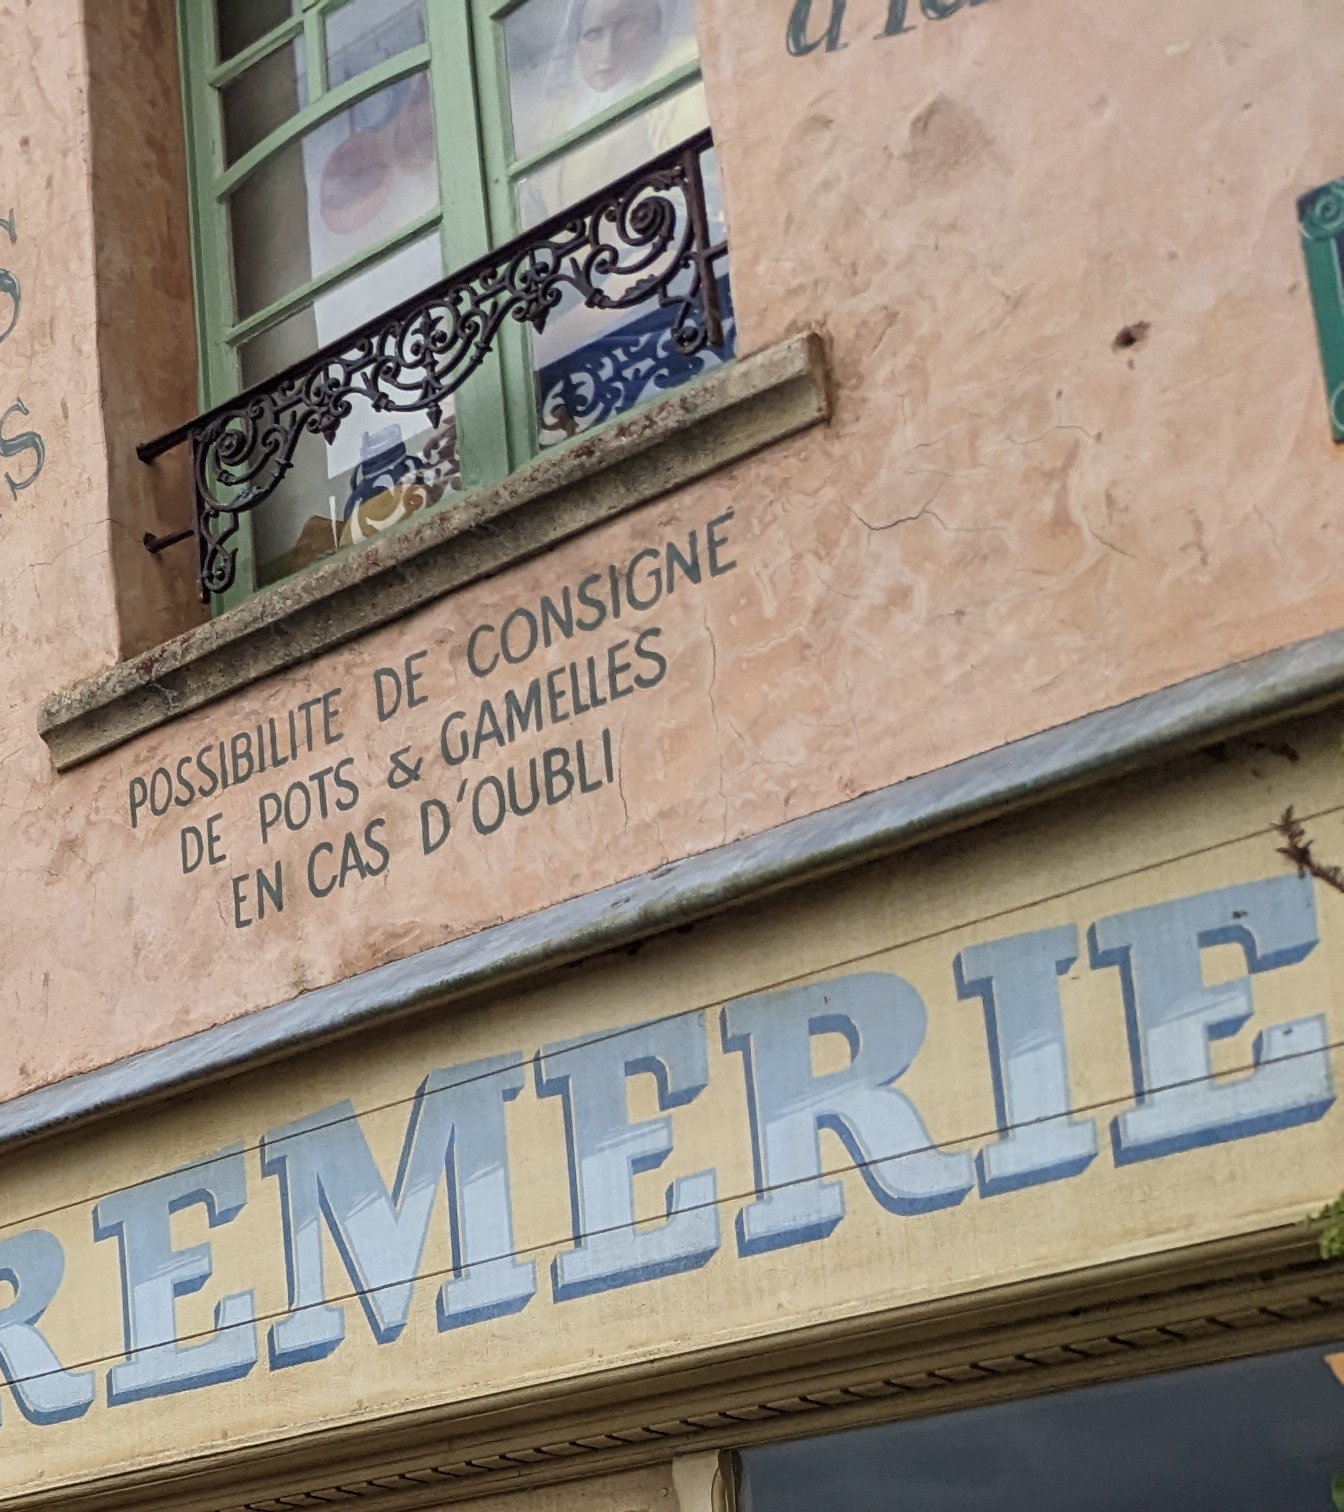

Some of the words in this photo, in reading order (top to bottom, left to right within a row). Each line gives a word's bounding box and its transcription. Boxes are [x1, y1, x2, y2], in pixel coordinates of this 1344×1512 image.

[128, 687, 343, 828] POSSIBILITE
[373, 649, 429, 723] DE
[466, 511, 738, 678] CONSIGNE
[180, 813, 226, 875] DE
[258, 757, 359, 845] POTS
[386, 745, 422, 790] &
[440, 626, 668, 767] GAMELLES
[231, 861, 283, 929] EN
[308, 818, 390, 898] CAS
[421, 728, 614, 855] D'OUBLI
